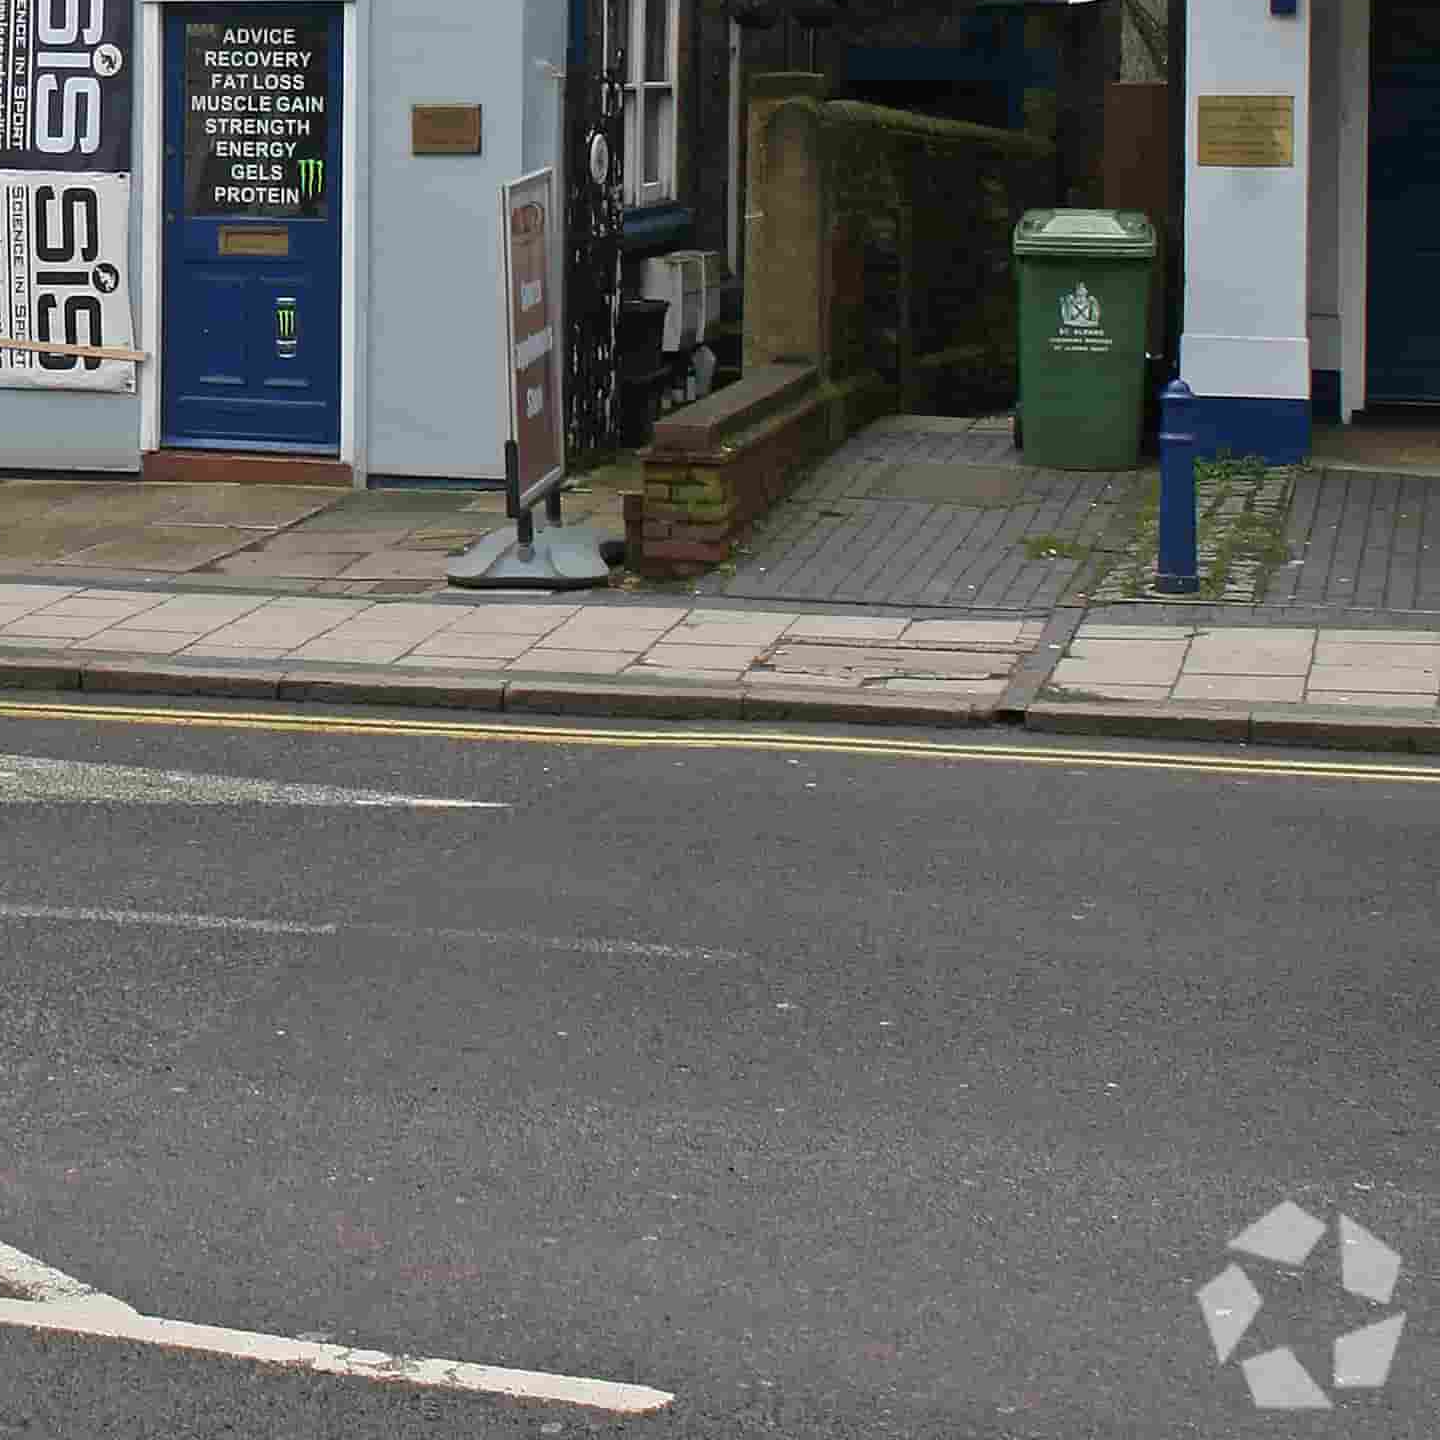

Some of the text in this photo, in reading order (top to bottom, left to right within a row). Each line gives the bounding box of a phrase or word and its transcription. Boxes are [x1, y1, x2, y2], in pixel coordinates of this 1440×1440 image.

[223, 28, 297, 45] ADVICE
[15, 56, 25, 75] IN
[205, 51, 312, 68] RECOVERY
[211, 73, 305, 90] FAT LOSS
[191, 95, 324, 112] MUSCLE GAIN
[12, 86, 27, 150] SPORT
[205, 118, 310, 135] STRENGTH
[215, 141, 297, 158] ENERGY
[231, 163, 283, 181] GELS
[214, 187, 299, 204] PROTEIN
[12, 185, 25, 268] SCIENCE
[15, 275, 25, 294] IN
